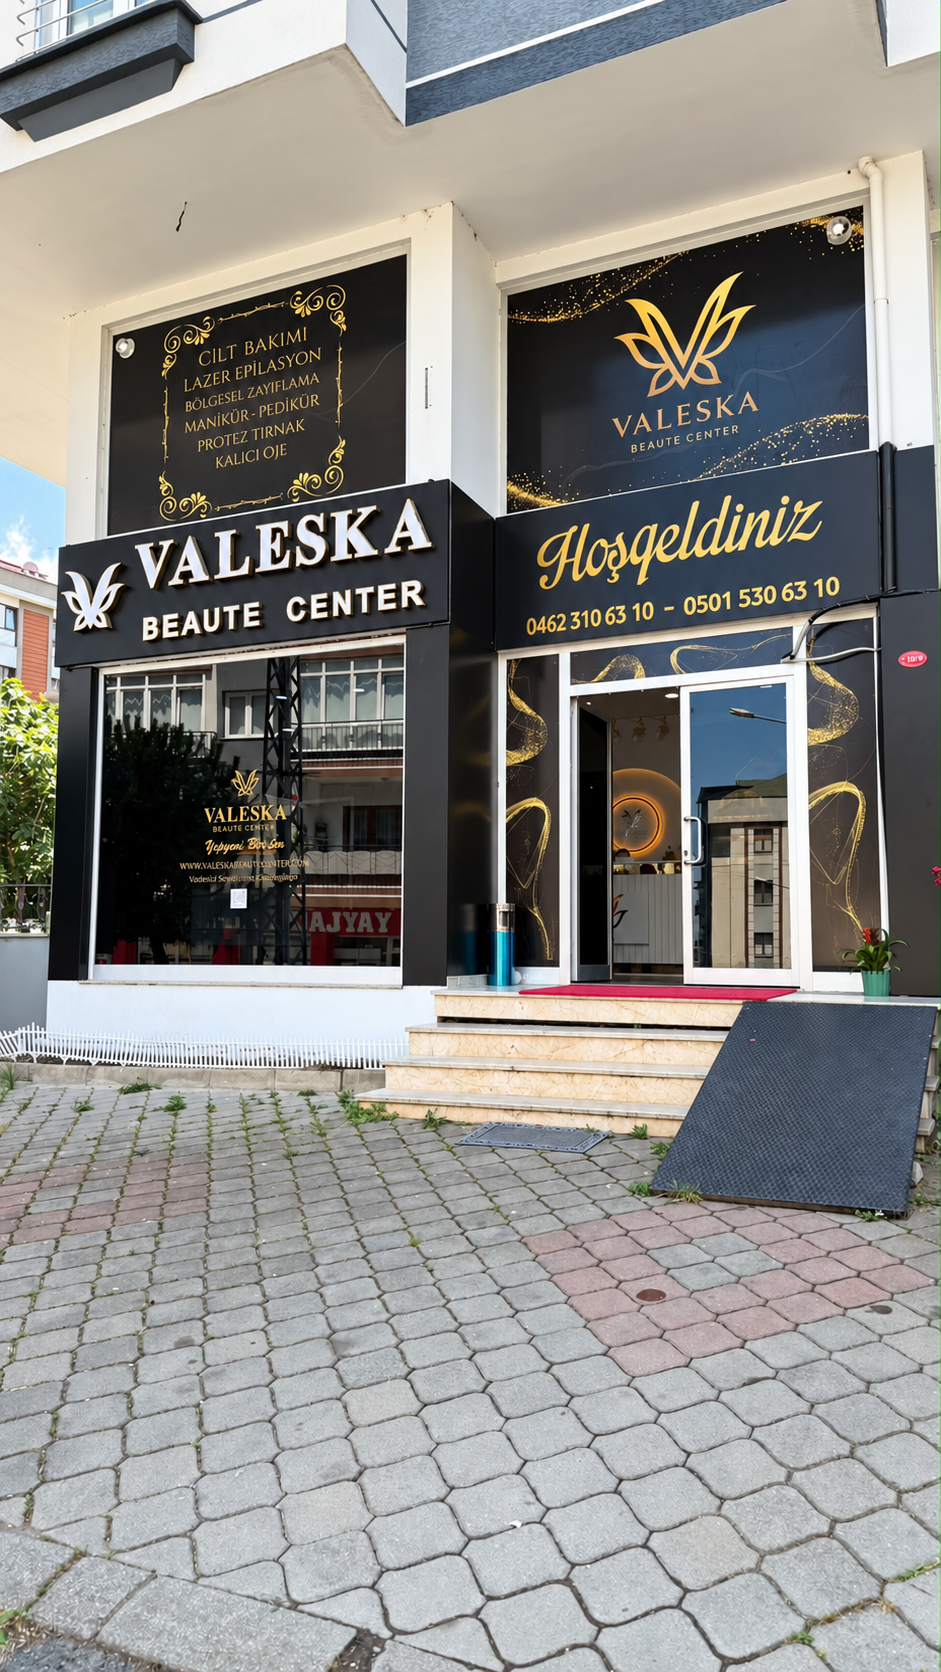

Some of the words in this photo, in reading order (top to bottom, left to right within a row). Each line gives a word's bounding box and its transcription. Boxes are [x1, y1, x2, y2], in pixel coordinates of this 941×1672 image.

[244, 326, 308, 356] BAKIMI
[183, 369, 232, 393] LAZER
[235, 346, 322, 381] EPİLASYON
[185, 389, 245, 413] BÖLGESEL
[247, 372, 320, 399] ZAYIFLAMA
[184, 408, 250, 434] MANİKÜR
[259, 393, 320, 418] PEDİKÜR
[611, 391, 759, 438] VALESKA
[197, 430, 249, 453] PROTEZ
[251, 418, 306, 441] TIRNAK
[215, 448, 260, 469] KALICI
[262, 443, 288, 461] OJE
[630, 435, 681, 454] BEAUTE
[686, 424, 740, 443] CENTER
[134, 498, 433, 590] VALESKA
[142, 601, 263, 642] BEAUTE
[286, 580, 427, 623] CENTER
[526, 614, 567, 636] 0462
[570, 608, 602, 630] 310
[604, 605, 627, 626] 63
[632, 601, 655, 621] 10
[683, 591, 733, 616] 0501
[738, 585, 778, 609] 530
[781, 580, 807, 603] 63
[813, 576, 841, 598] 10
[204, 804, 287, 823] VALESKA
[212, 825, 243, 833] BEAUTE
